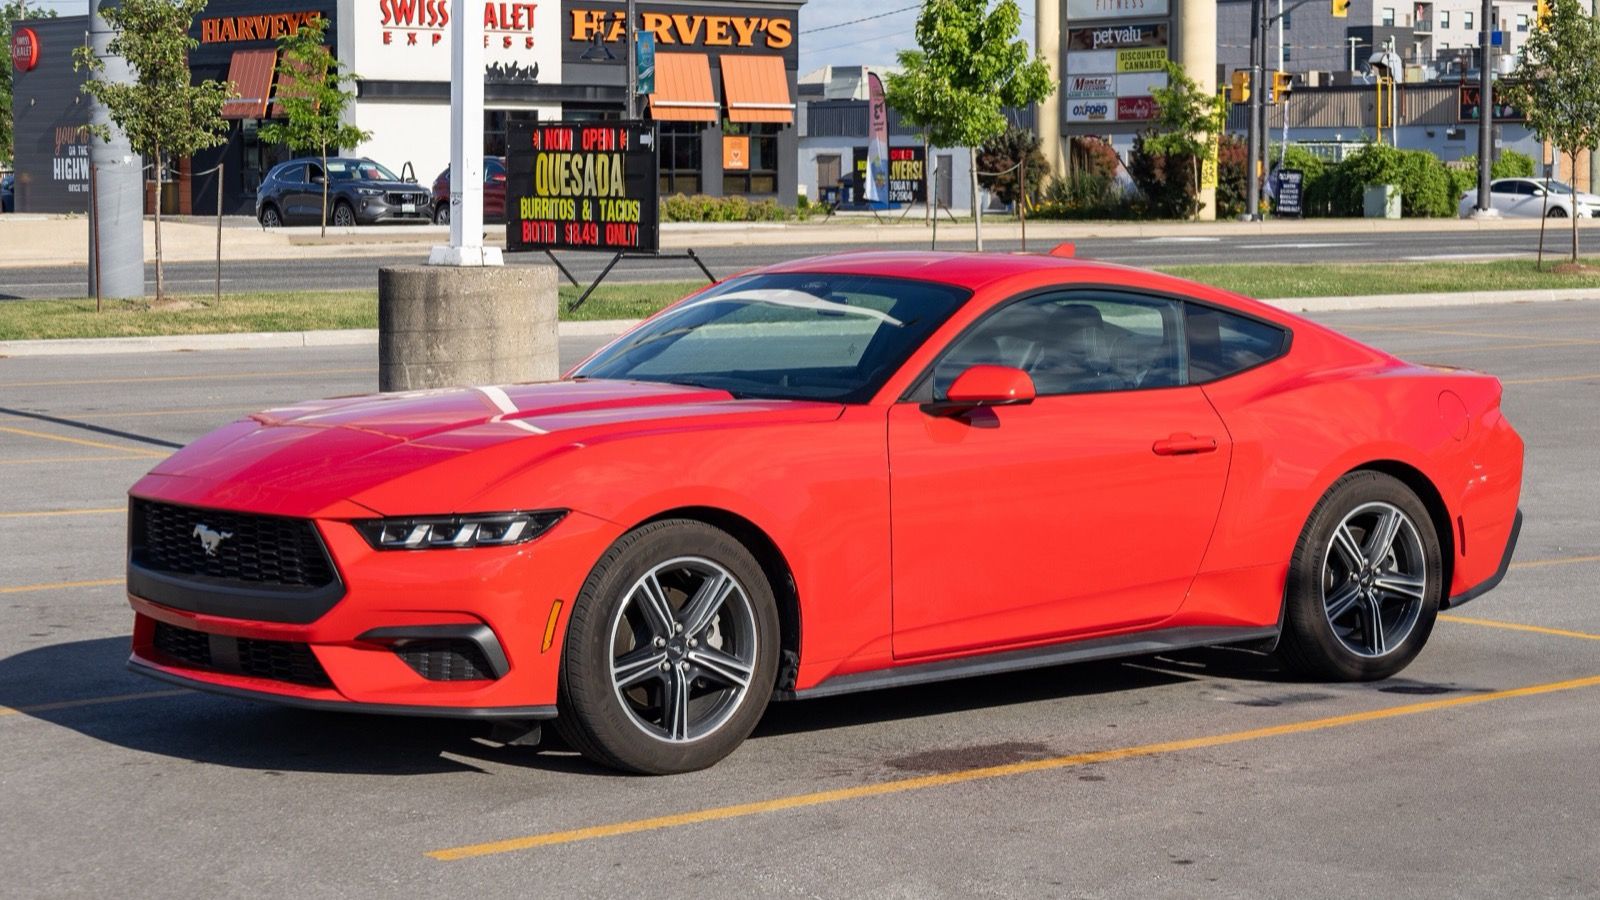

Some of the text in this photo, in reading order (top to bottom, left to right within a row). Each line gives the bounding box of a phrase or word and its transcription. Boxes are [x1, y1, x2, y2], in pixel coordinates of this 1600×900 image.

[380, 0, 449, 27] SWISS
[484, 2, 538, 30] ALET
[382, 31, 535, 49] EXPESS
[570, 9, 793, 49] HARVEY'S
[1120, 50, 1166, 61] DISCOUNTED
[1124, 60, 1162, 70] CANNABIS
[1073, 103, 1108, 116] OXFORD
[544, 127, 613, 150] NOW OPEN
[78, 145, 88, 156] THE
[53, 157, 89, 180] HIGHW
[535, 152, 624, 198] QUESADA
[520, 197, 640, 222] BURRITOS & TACOS
[565, 222, 599, 246] $8.49
[606, 223, 638, 247] ONLY
